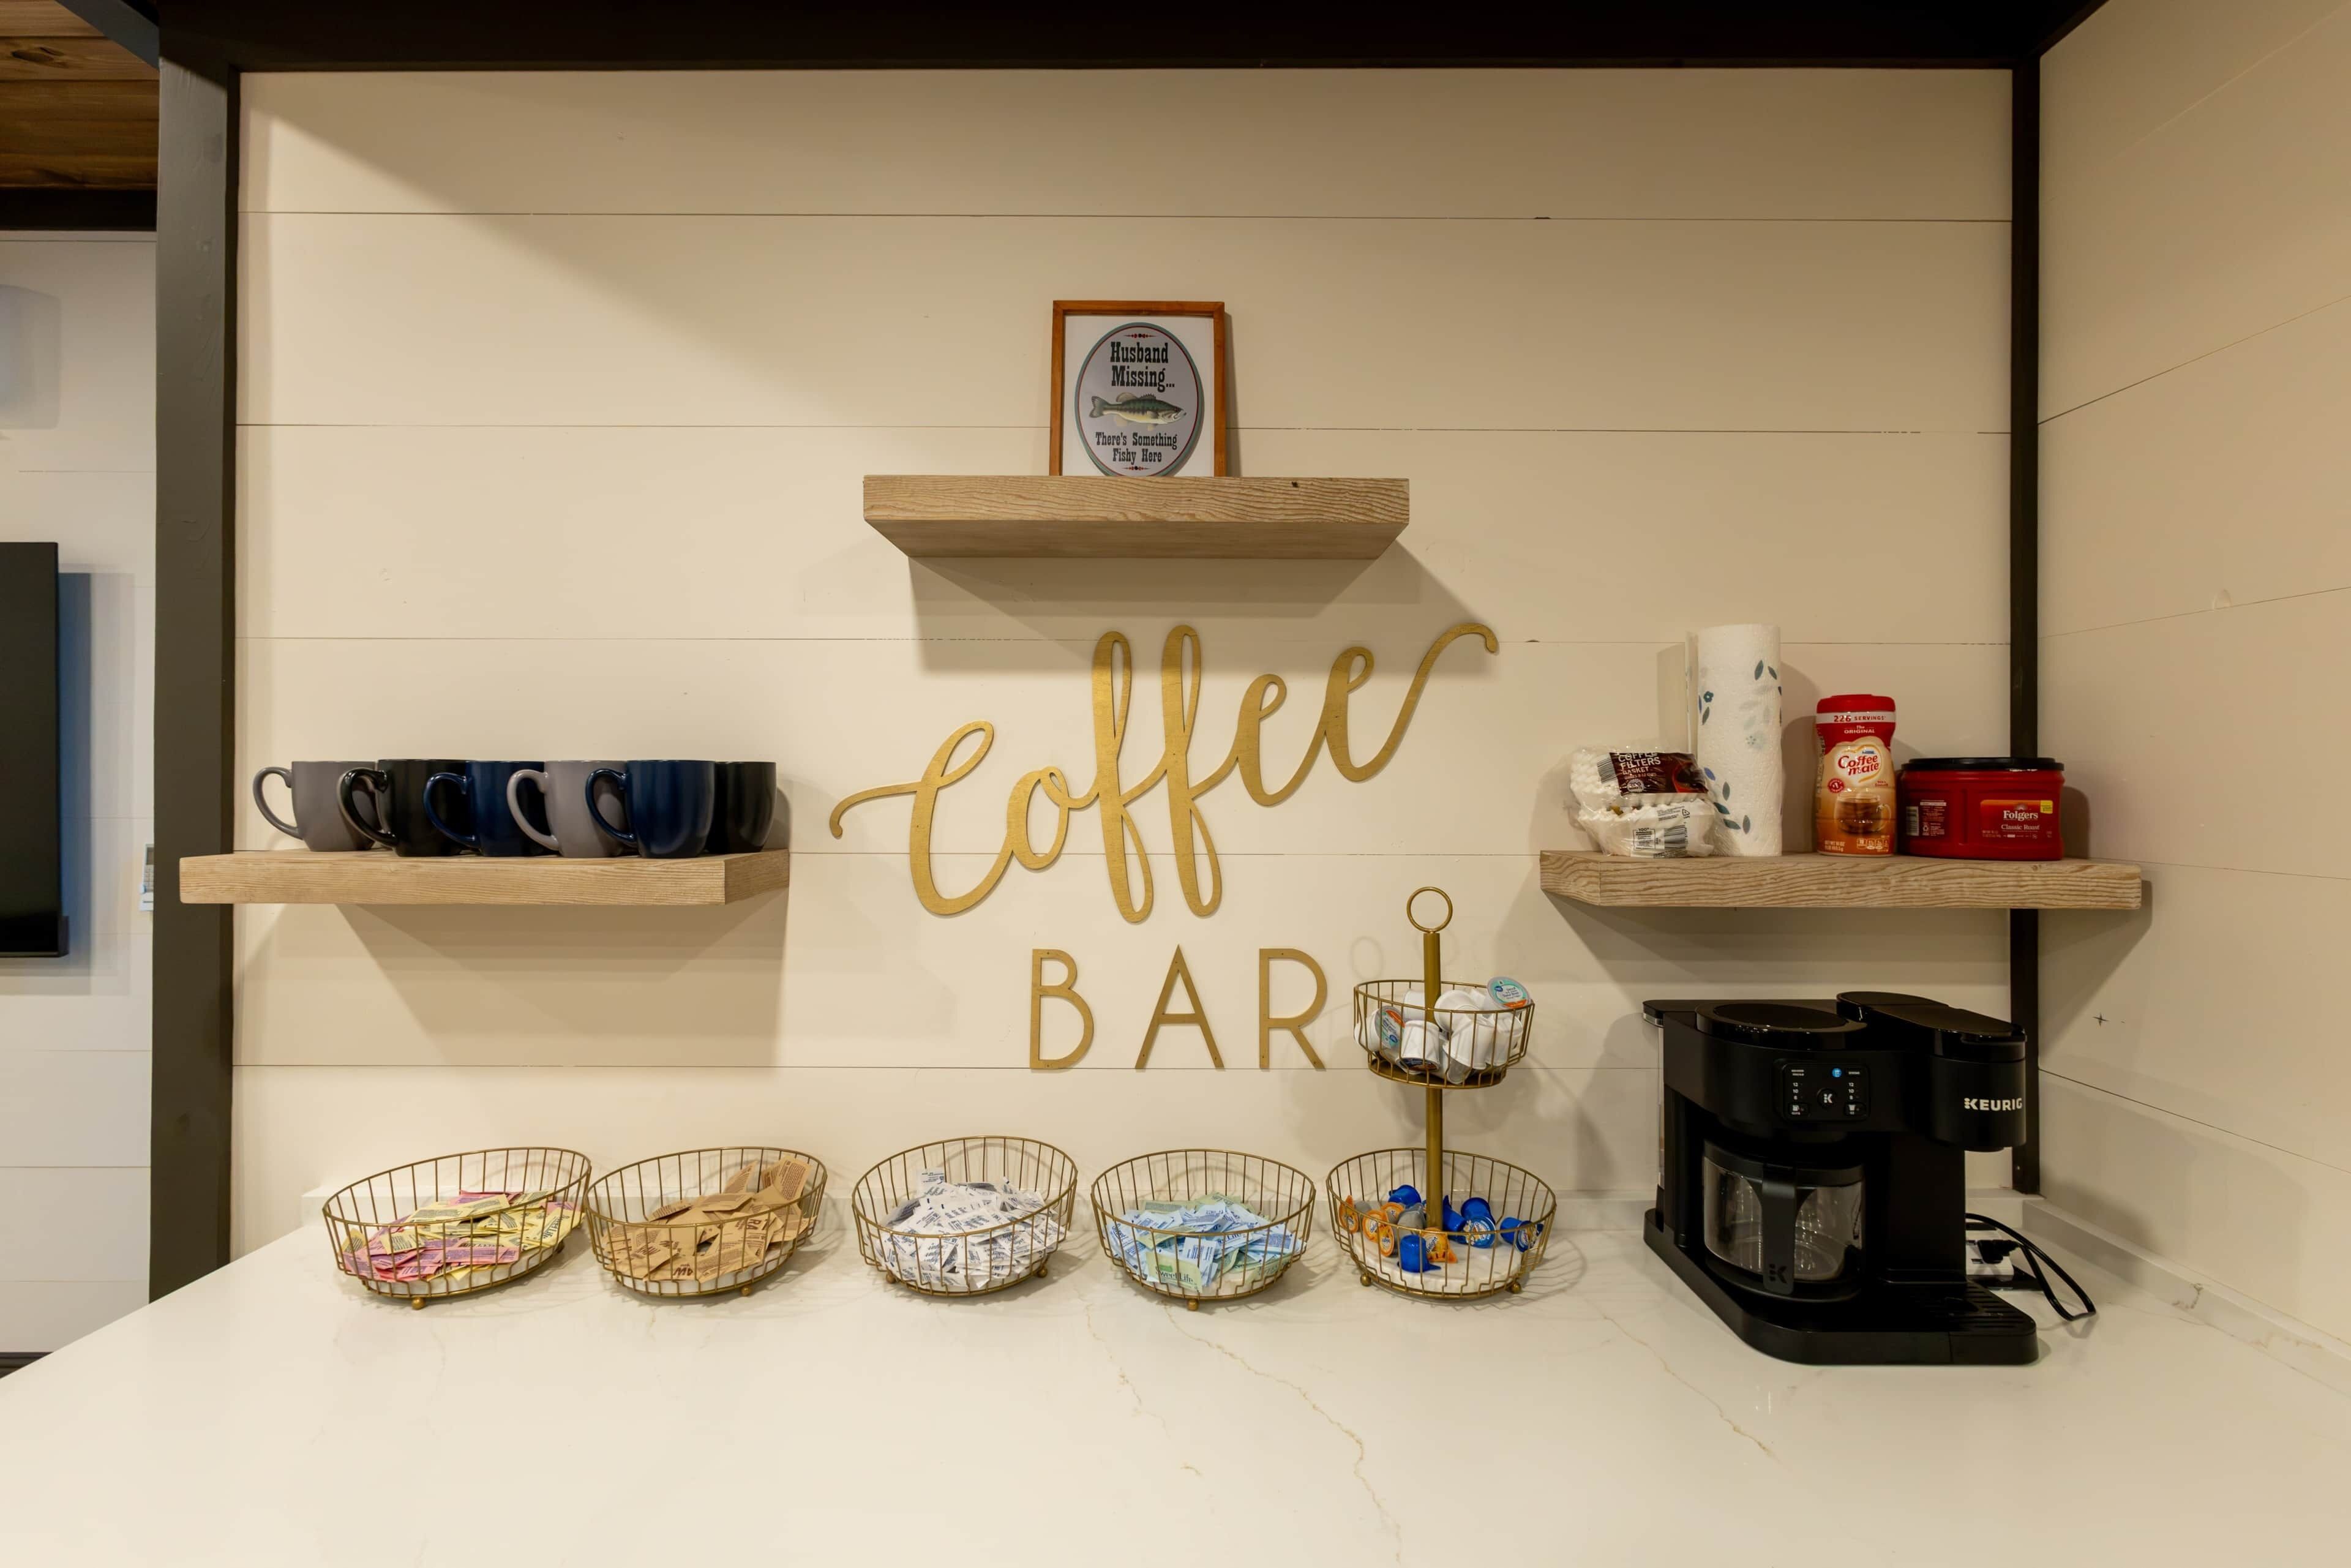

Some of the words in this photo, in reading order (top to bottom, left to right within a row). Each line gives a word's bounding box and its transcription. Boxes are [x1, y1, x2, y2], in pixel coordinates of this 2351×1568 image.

[1110, 342, 1168, 363] Husband
[1111, 366, 1175, 392] Missing...
[1095, 432, 1127, 446] There's
[1133, 433, 1177, 450] Something
[1112, 448, 1136, 465] Fishy
[1142, 448, 1162, 462] Here
[1620, 757, 1661, 770] FILTERS
[1838, 755, 1878, 769] Coffee
[1848, 763, 1879, 776] mate
[830, 625, 1499, 924] Coffee
[2003, 810, 2038, 821] Folgers
[1031, 944, 1327, 1070] BAR
[1964, 1097, 2022, 1111] KEURIG
